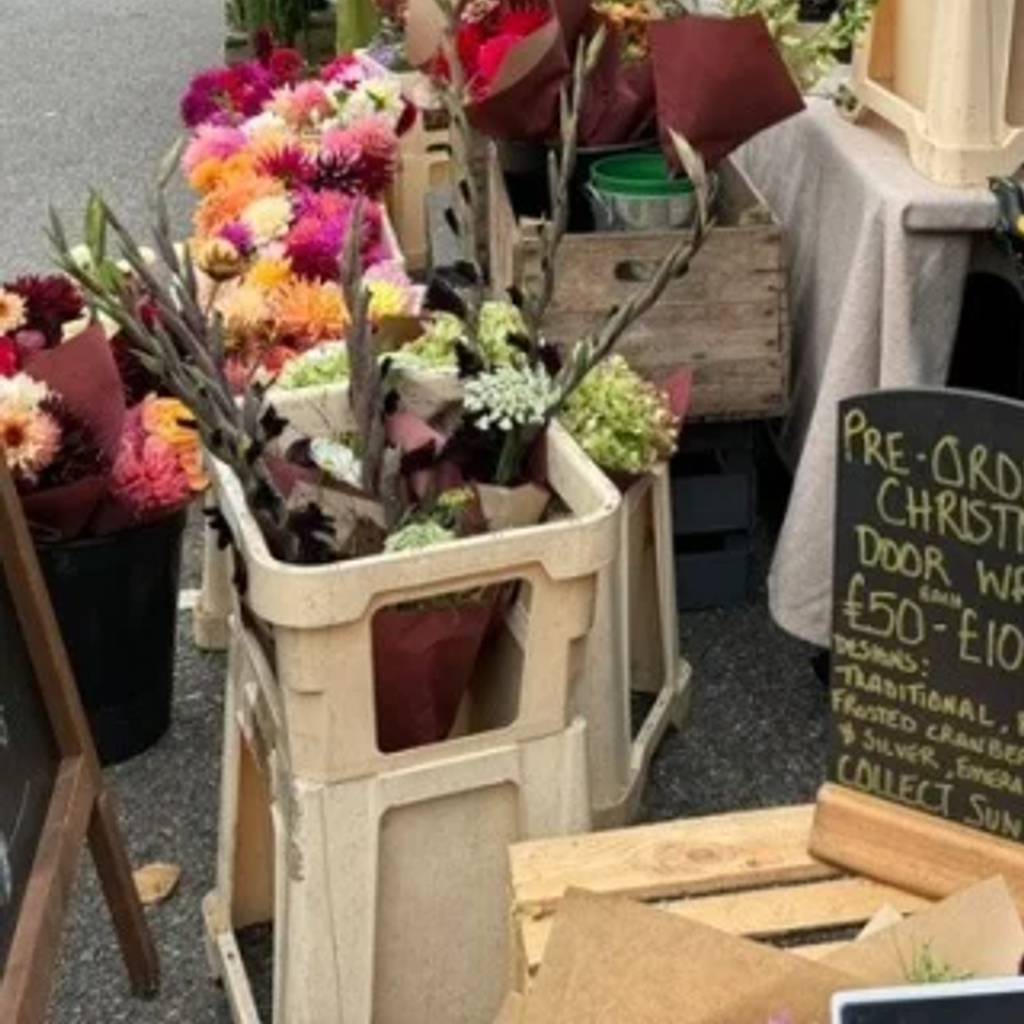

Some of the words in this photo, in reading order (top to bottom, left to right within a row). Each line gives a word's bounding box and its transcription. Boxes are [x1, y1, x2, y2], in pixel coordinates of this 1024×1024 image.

[854, 524, 952, 587] DOOR
[842, 572, 926, 645] £50
[958, 608, 1024, 672] £10
[831, 688, 918, 732] FROSTED
[837, 754, 955, 818] COLLECT
